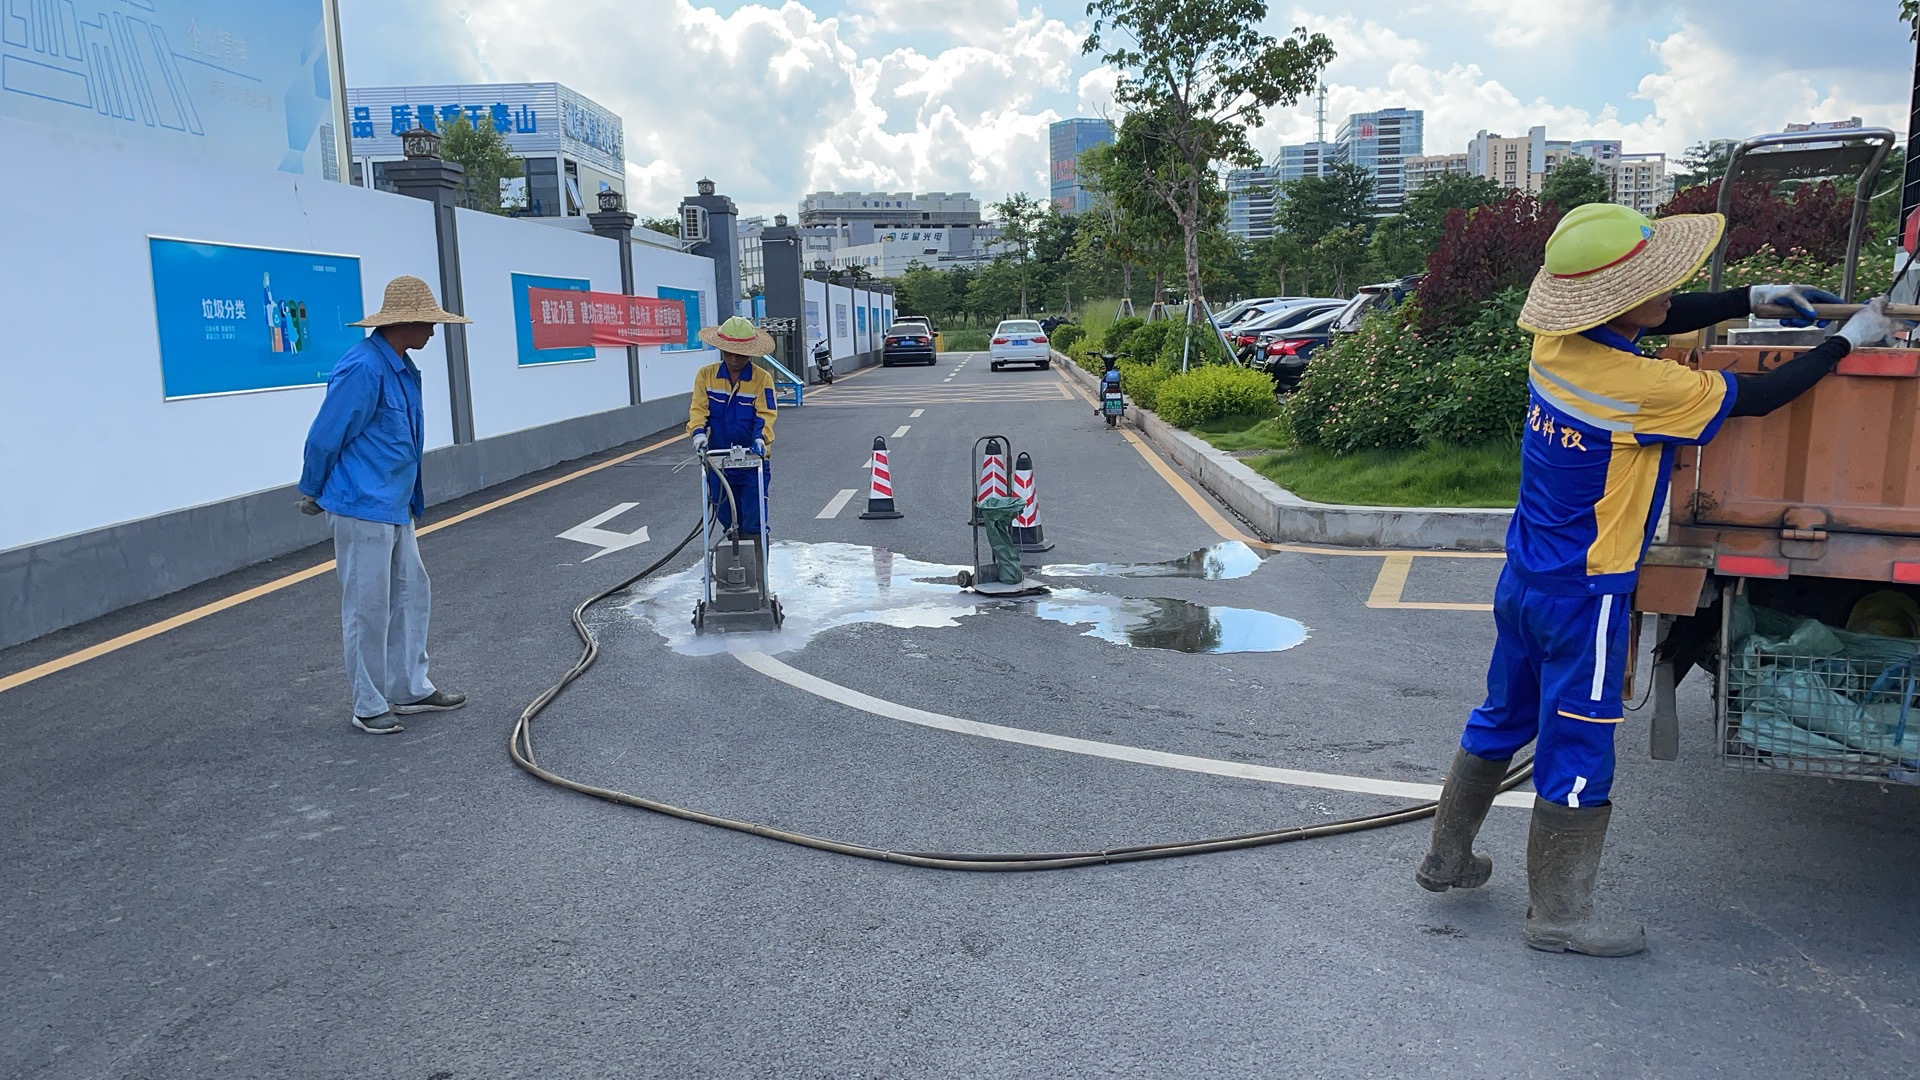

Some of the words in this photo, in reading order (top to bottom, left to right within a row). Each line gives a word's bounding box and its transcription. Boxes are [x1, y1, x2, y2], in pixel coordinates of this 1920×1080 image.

[899, 232, 943, 242] 华星光电
[201, 298, 247, 320] 垃圾分类
[541, 298, 576, 325] 建证力量
